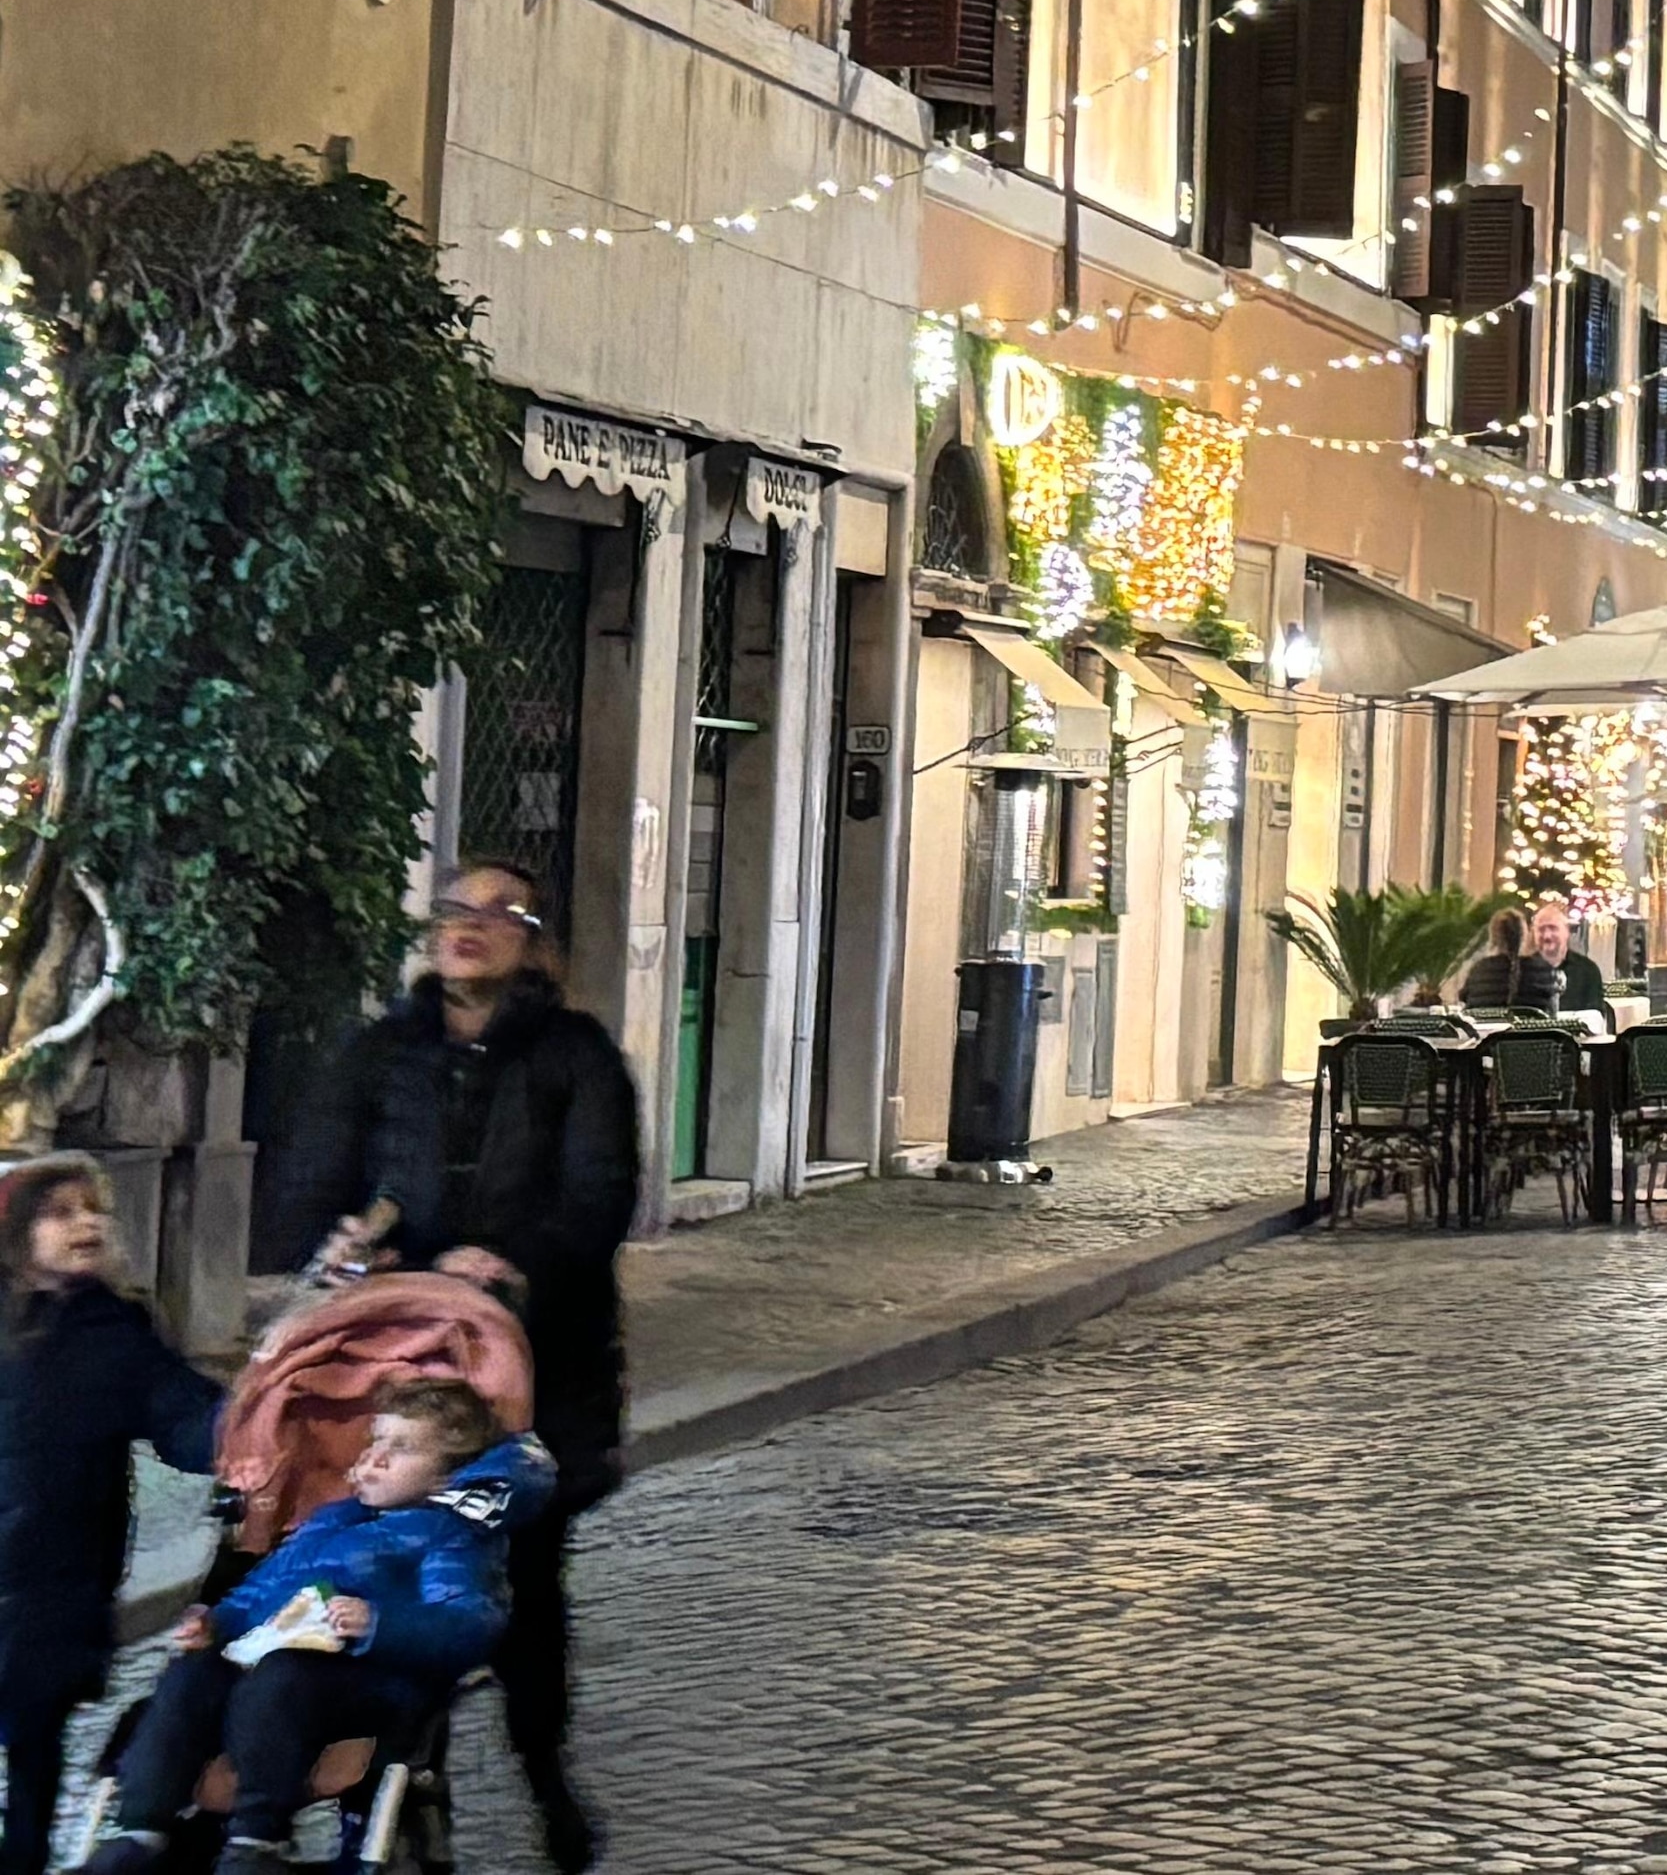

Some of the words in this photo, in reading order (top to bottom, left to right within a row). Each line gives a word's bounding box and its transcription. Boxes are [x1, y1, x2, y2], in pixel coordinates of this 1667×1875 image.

[543, 415, 591, 466] PANE
[597, 428, 611, 469] E
[618, 433, 671, 481] PIZZA
[763, 466, 808, 512] DOLCI
